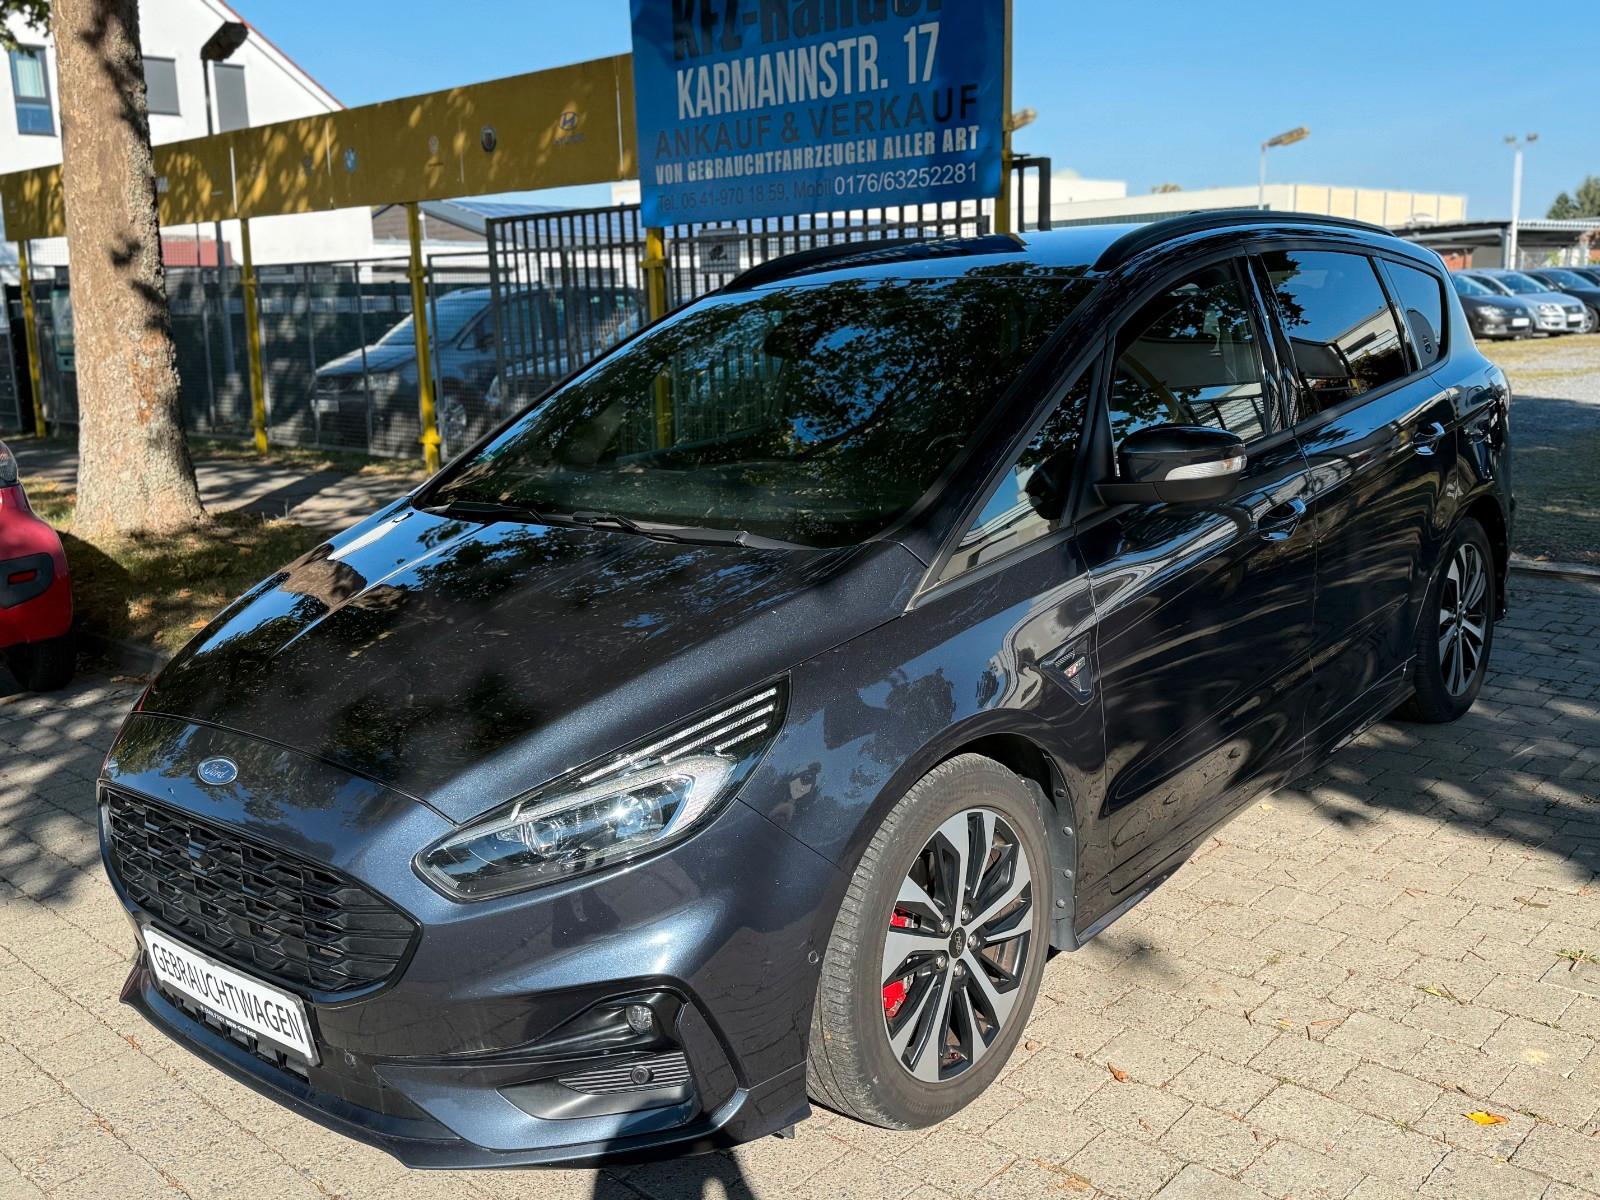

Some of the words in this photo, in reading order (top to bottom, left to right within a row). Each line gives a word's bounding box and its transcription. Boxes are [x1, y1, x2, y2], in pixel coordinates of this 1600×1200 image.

[677, 35, 889, 120] KARMANNSTR.
[903, 22, 940, 84] 17
[655, 114, 772, 160] ANKAUF
[781, 111, 801, 144] &
[808, 83, 979, 139] VERKAUF
[656, 164, 683, 185] VON
[687, 136, 877, 182] GEBRAUCHTFAHRZEUGEN
[883, 131, 936, 160] ALLER
[942, 125, 980, 153] ART
[834, 161, 977, 195] 0176/63252281
[152, 942, 305, 1044] GEBRAUCHTWAGEN
